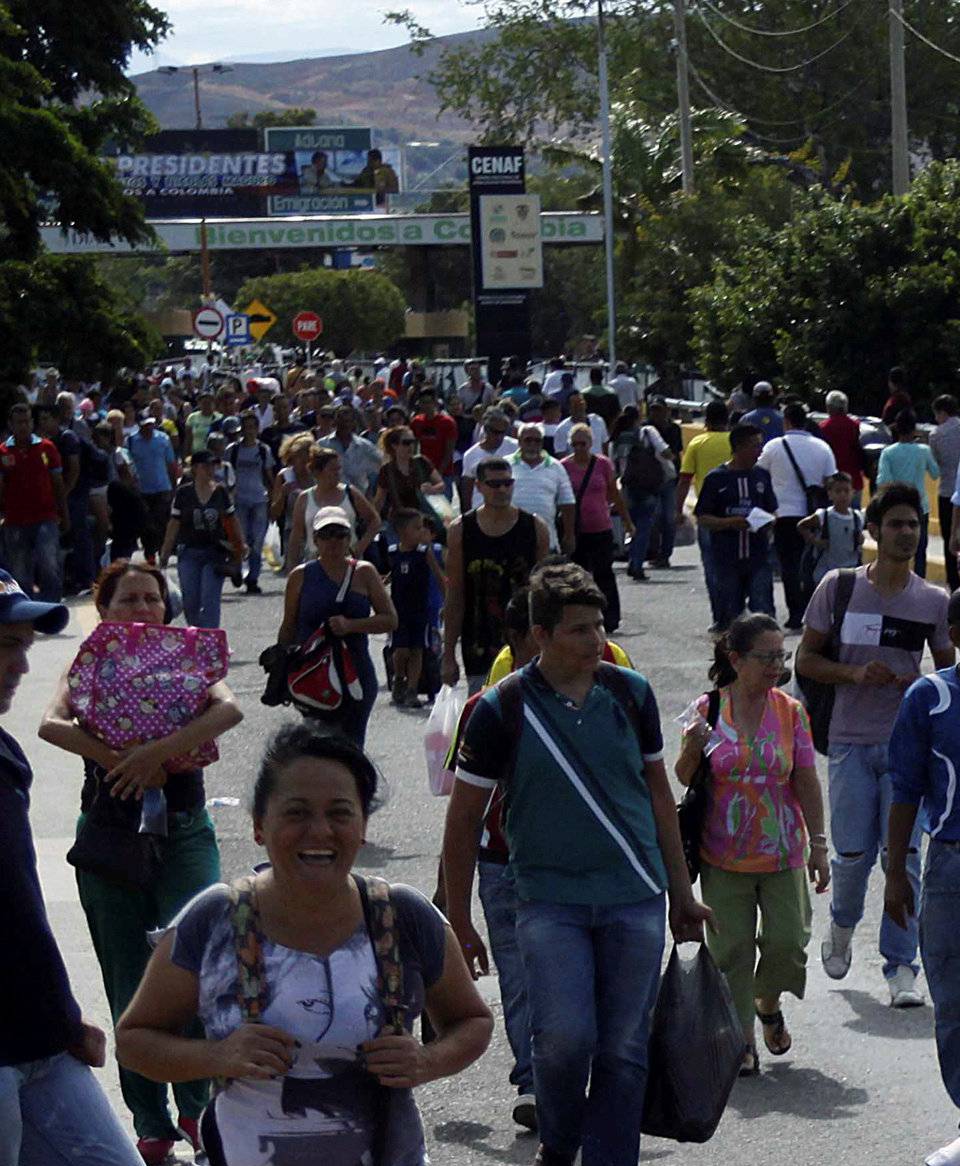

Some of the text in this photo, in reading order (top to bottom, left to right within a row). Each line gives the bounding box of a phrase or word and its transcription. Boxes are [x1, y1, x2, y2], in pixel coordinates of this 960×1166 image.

[471, 155, 523, 174] CENAF
[194, 222, 395, 245] Bienvenidos
[402, 224, 423, 240] a
[433, 217, 587, 240] Cobia
[232, 318, 242, 335] P
